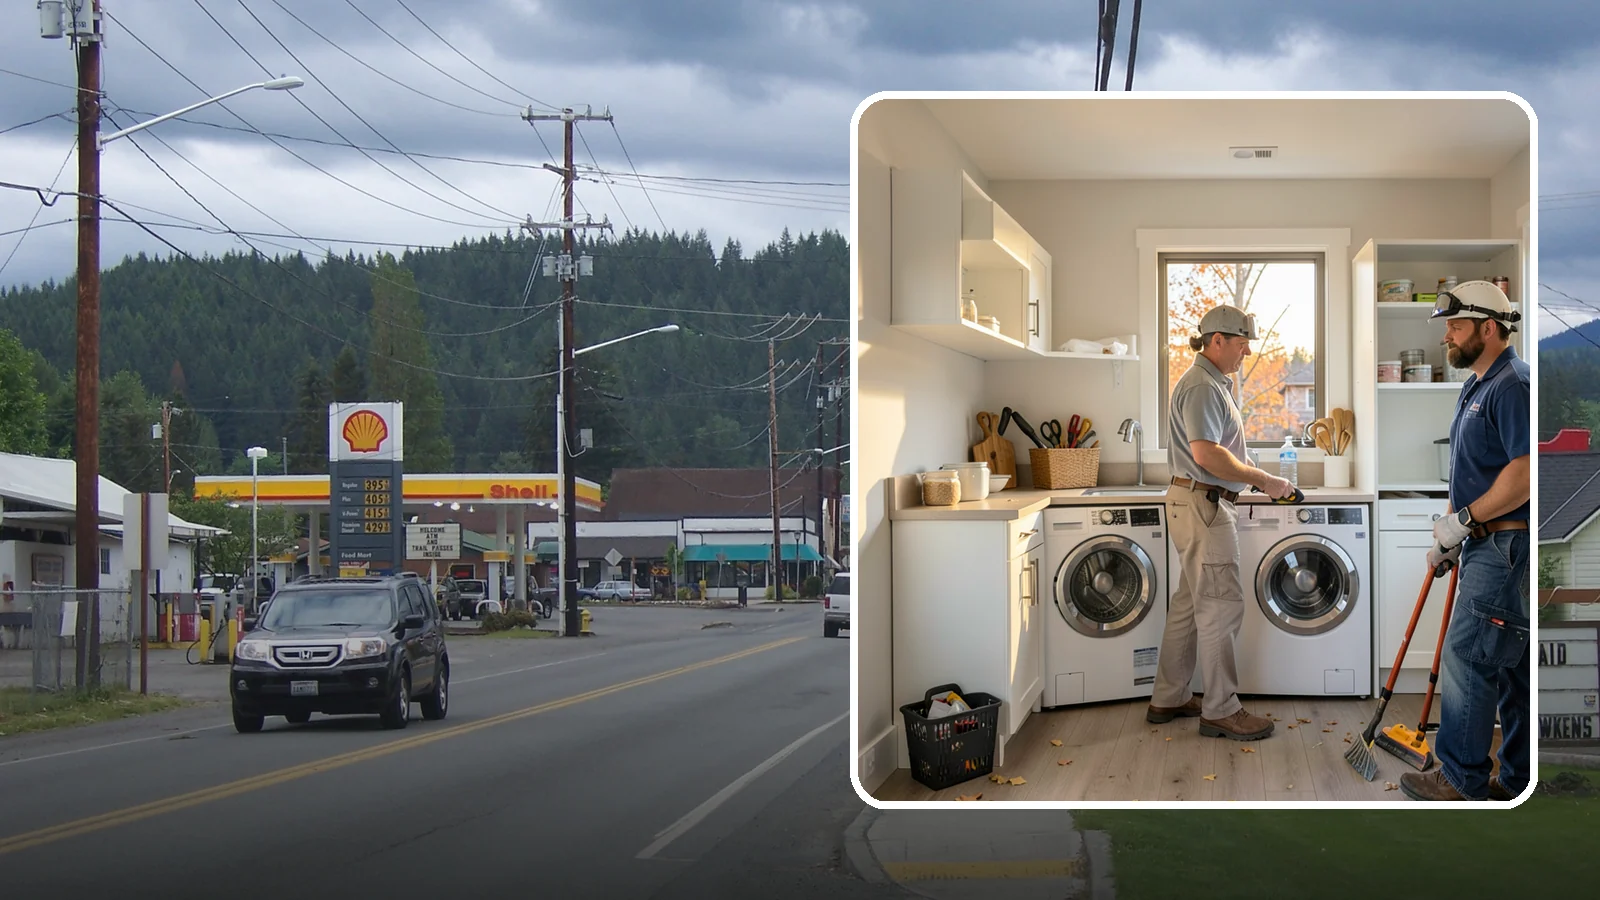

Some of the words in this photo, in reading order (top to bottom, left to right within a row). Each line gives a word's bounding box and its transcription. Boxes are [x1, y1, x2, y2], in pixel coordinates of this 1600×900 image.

[365, 480, 384, 490] 395
[490, 484, 548, 499] Shell
[365, 494, 384, 504] 405
[365, 508, 384, 518] 415
[365, 522, 384, 532] 429
